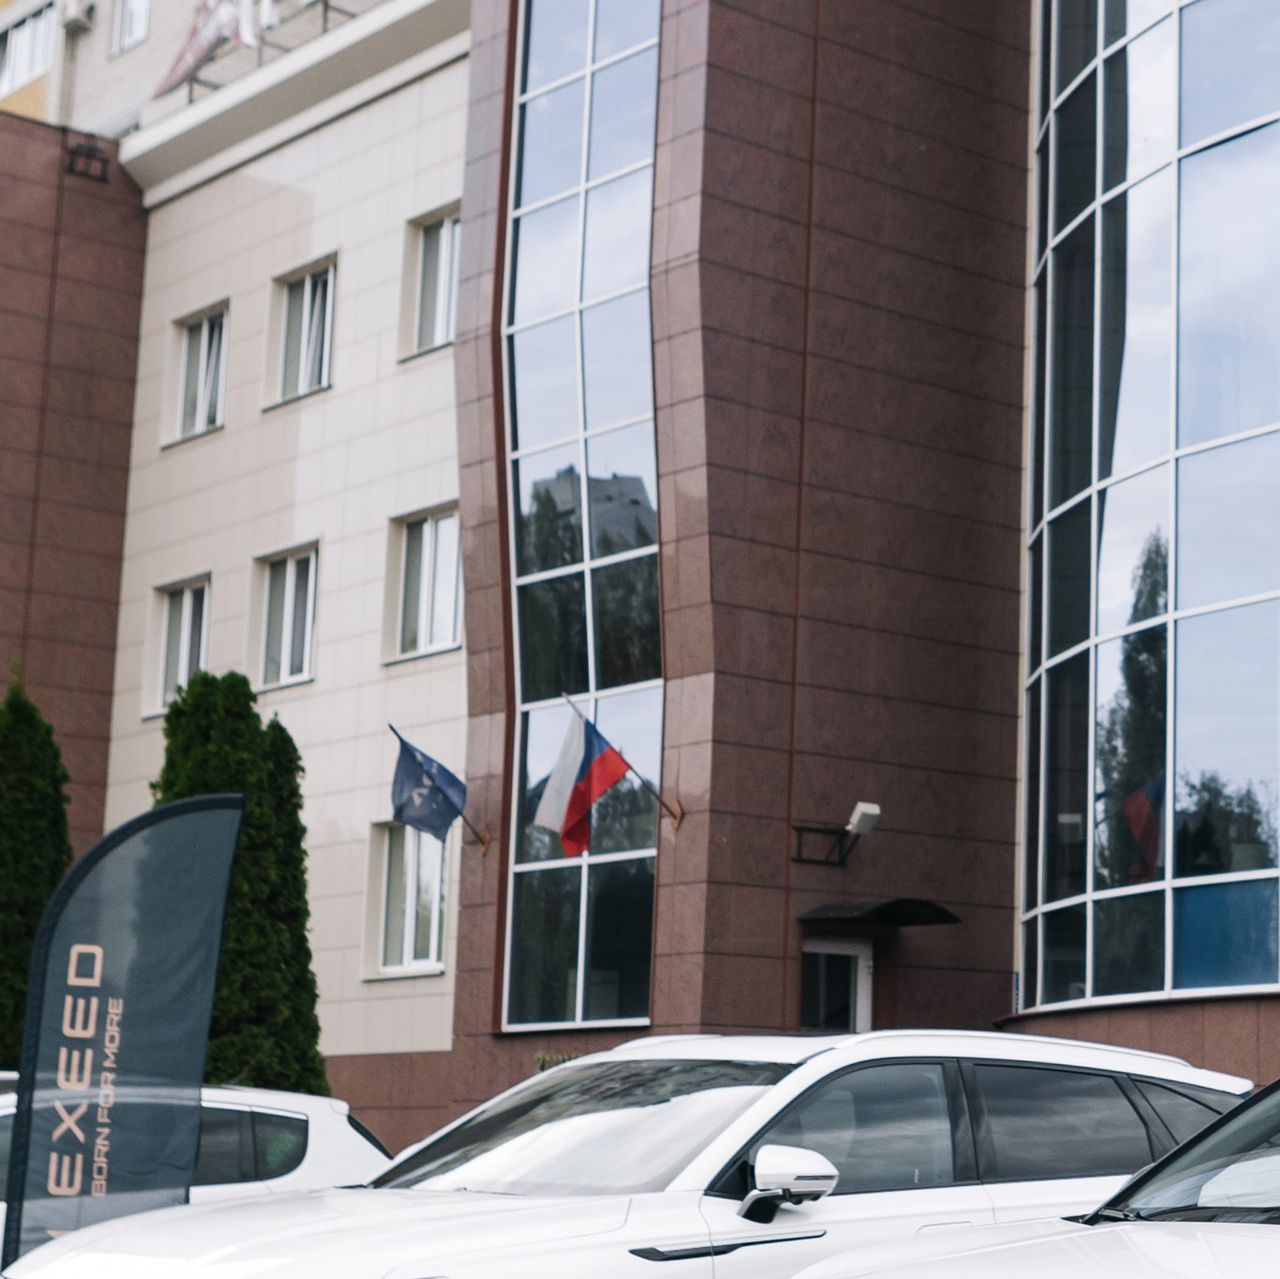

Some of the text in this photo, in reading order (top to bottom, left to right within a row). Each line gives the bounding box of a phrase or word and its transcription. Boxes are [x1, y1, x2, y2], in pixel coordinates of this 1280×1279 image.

[47, 943, 103, 1197] EXEED
[91, 998, 124, 1198] BORN FOR MORE
